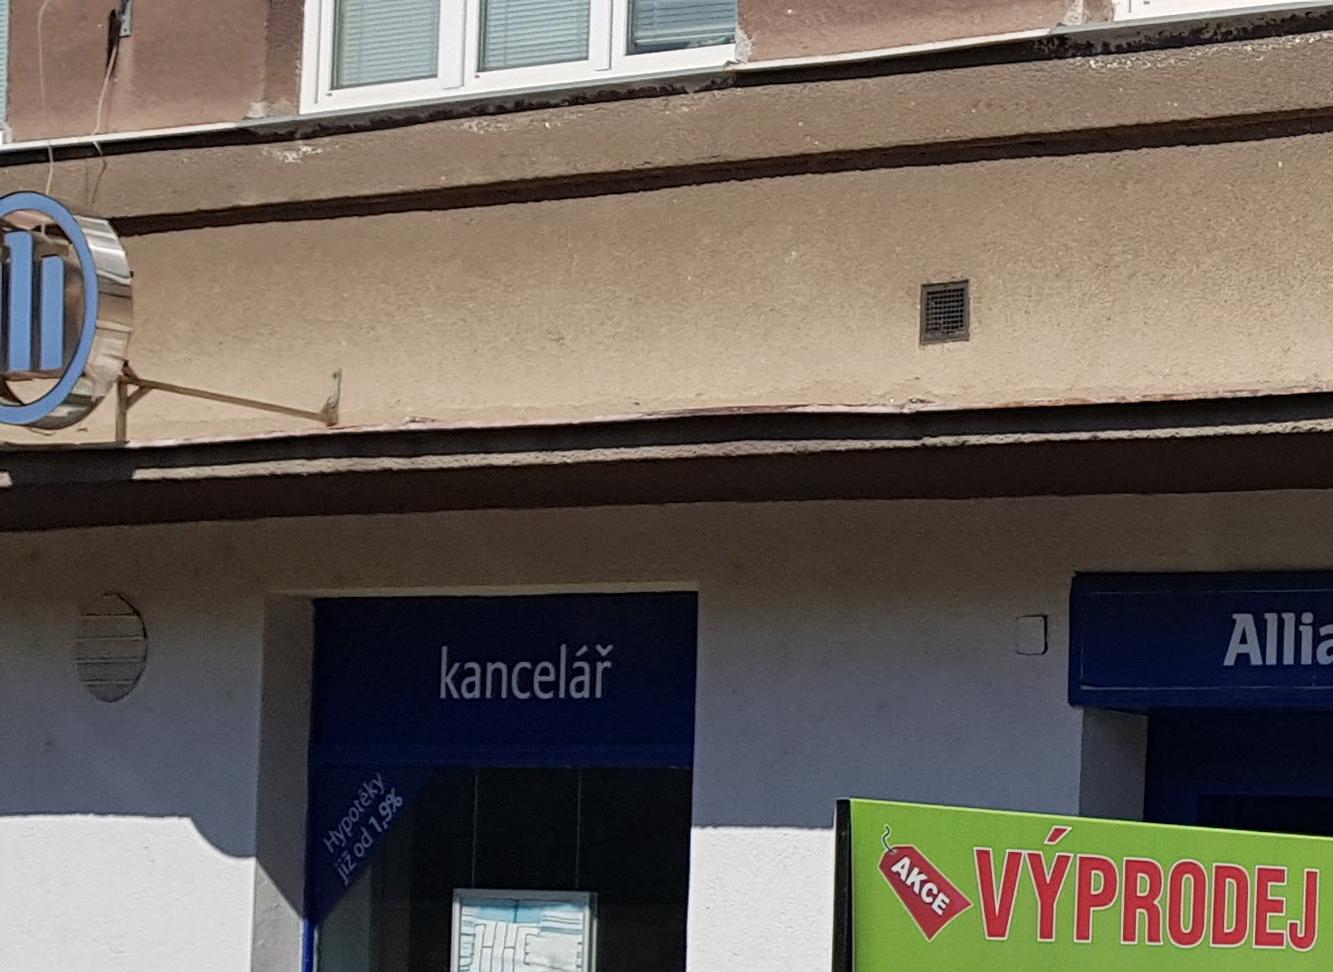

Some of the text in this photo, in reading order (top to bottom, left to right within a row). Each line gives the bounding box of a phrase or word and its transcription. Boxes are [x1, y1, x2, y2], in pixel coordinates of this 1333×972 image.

[440, 644, 616, 700] kancelář
[353, 826, 373, 857] od
[368, 787, 403, 832] 1,9%
[890, 857, 950, 916] AKCE
[973, 826, 1320, 951] VÝPRODEJ
